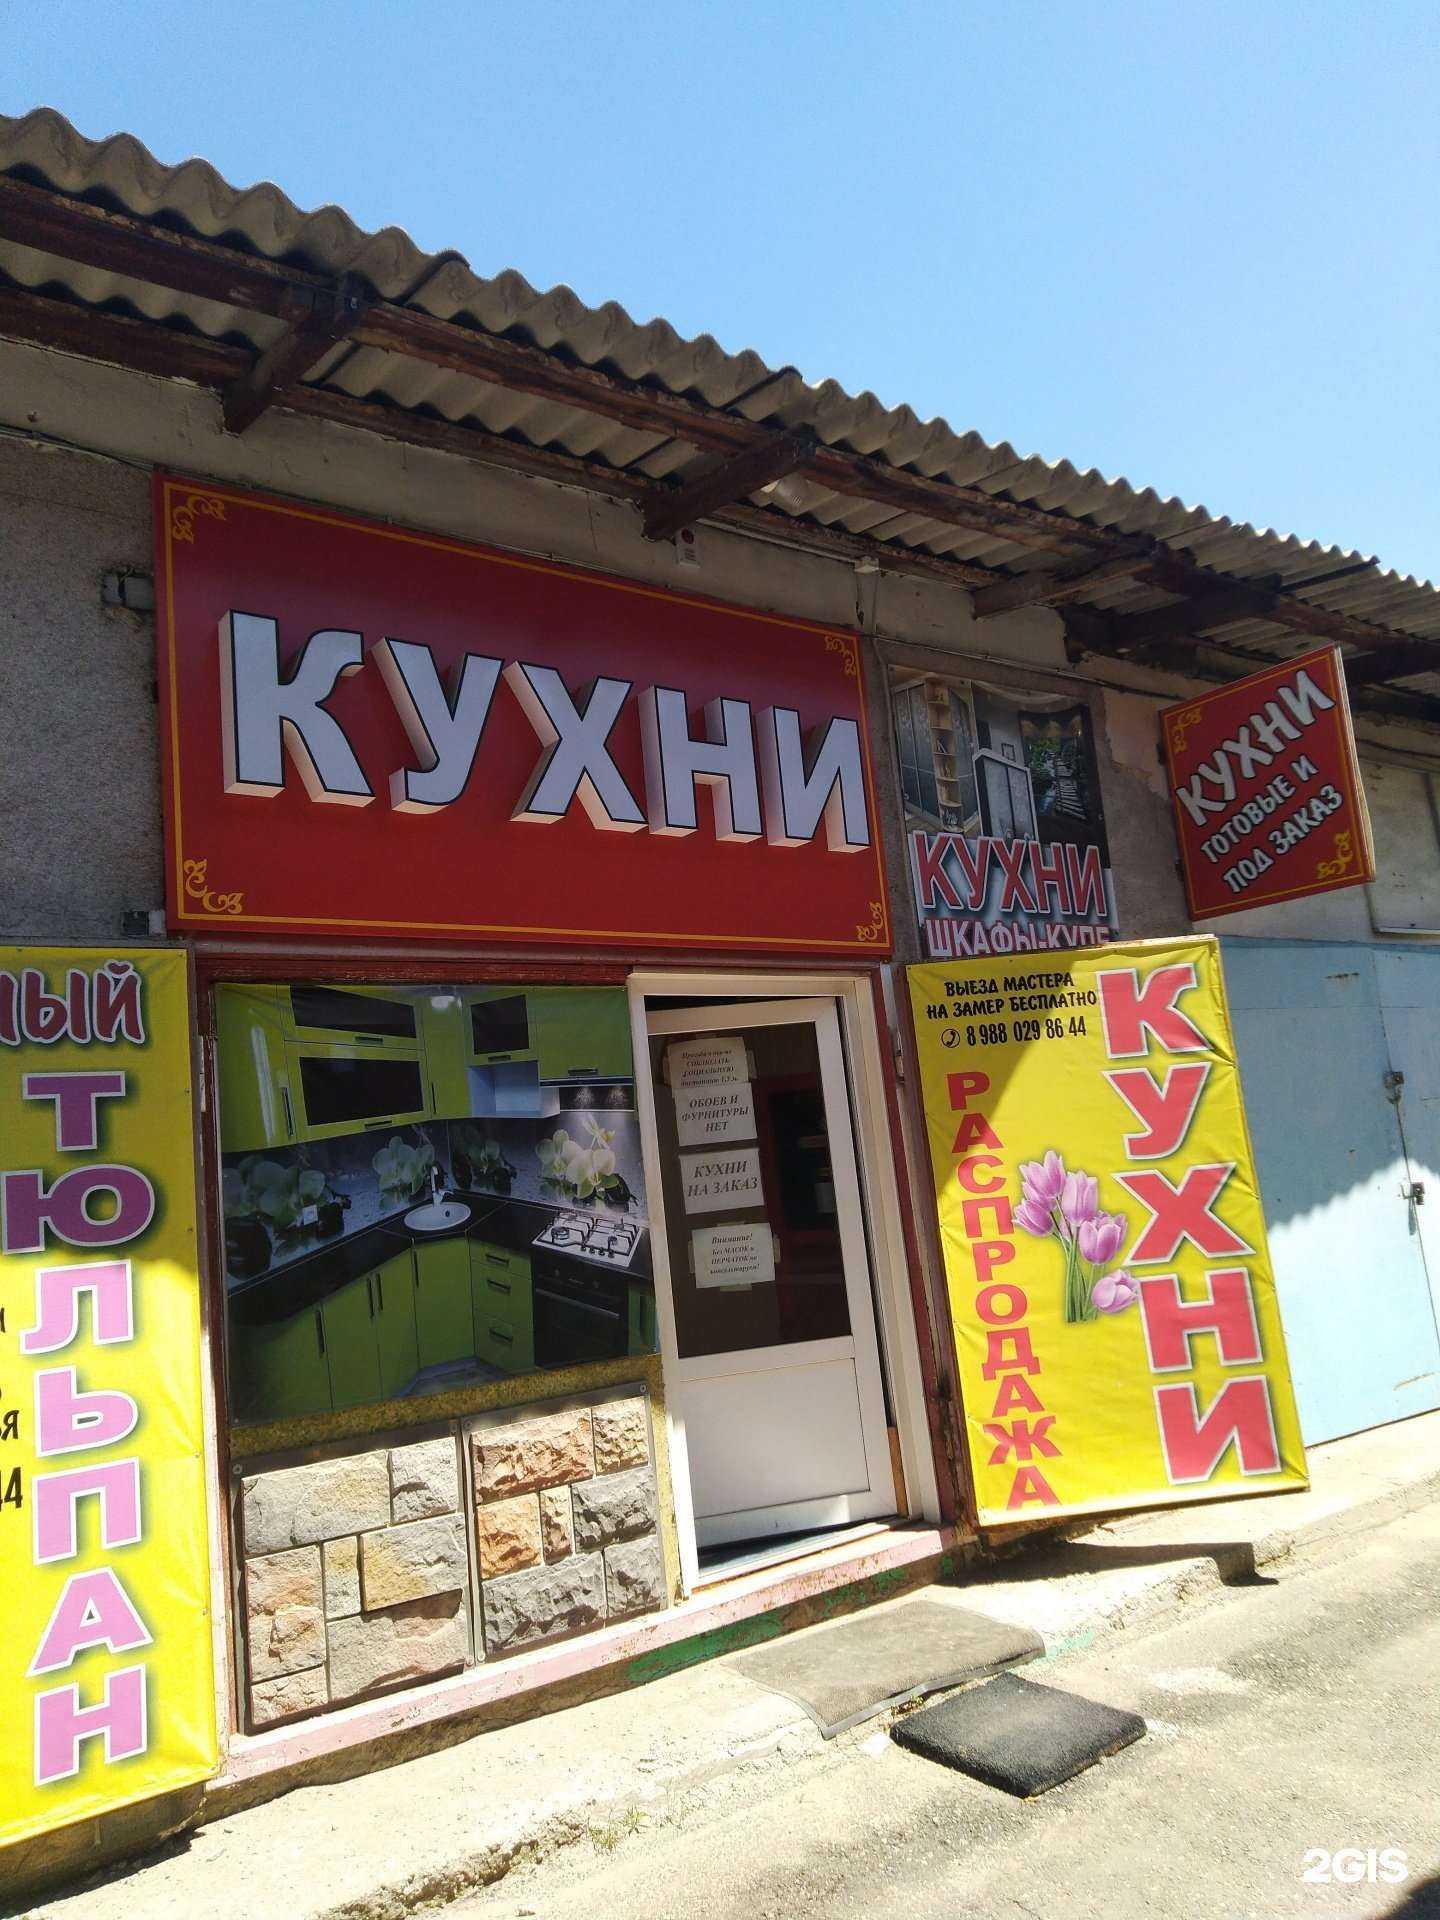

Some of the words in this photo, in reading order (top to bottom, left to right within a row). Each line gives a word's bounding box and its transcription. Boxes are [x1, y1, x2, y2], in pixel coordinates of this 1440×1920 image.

[218, 608, 870, 854] КУХНИ
[1175, 669, 1336, 827] КУХНИ
[1200, 774, 1296, 863] ГОТОВЫЕ
[1222, 848, 1274, 893] ПОД
[1268, 785, 1343, 854] ЗАКАЗ
[913, 830, 1107, 917] КУХНИ
[927, 1004, 948, 1019] НА
[953, 998, 1005, 1017] ЗАМЕР
[1009, 990, 1097, 1012] БЕСПЛАТНО
[944, 978, 998, 997] ВЫЕЗД
[1003, 972, 1075, 992] МАСТЕРА
[966, 1025, 977, 1046] 8
[979, 1022, 1008, 1045] 988
[1013, 1019, 1041, 1042] 029
[1046, 1018, 1064, 1039] 86
[1069, 1015, 1086, 1036] 44
[681, 1106, 749, 1121] ФУРНИТУРЫ
[689, 1096, 727, 1108] ОБОЕВ
[705, 1121, 728, 1132] НЕТ
[688, 1184, 708, 1197] НА
[712, 1177, 757, 1193] ЗАКАЗ
[694, 1161, 747, 1178] КУХНИ
[1098, 962, 1282, 1486] КУХНИ
[946, 1071, 1062, 1511] РАСПРОДАЖА
[0, 1071, 156, 1787] ТЮЛЬПАН
[0, 1466, 23, 1512] 4
